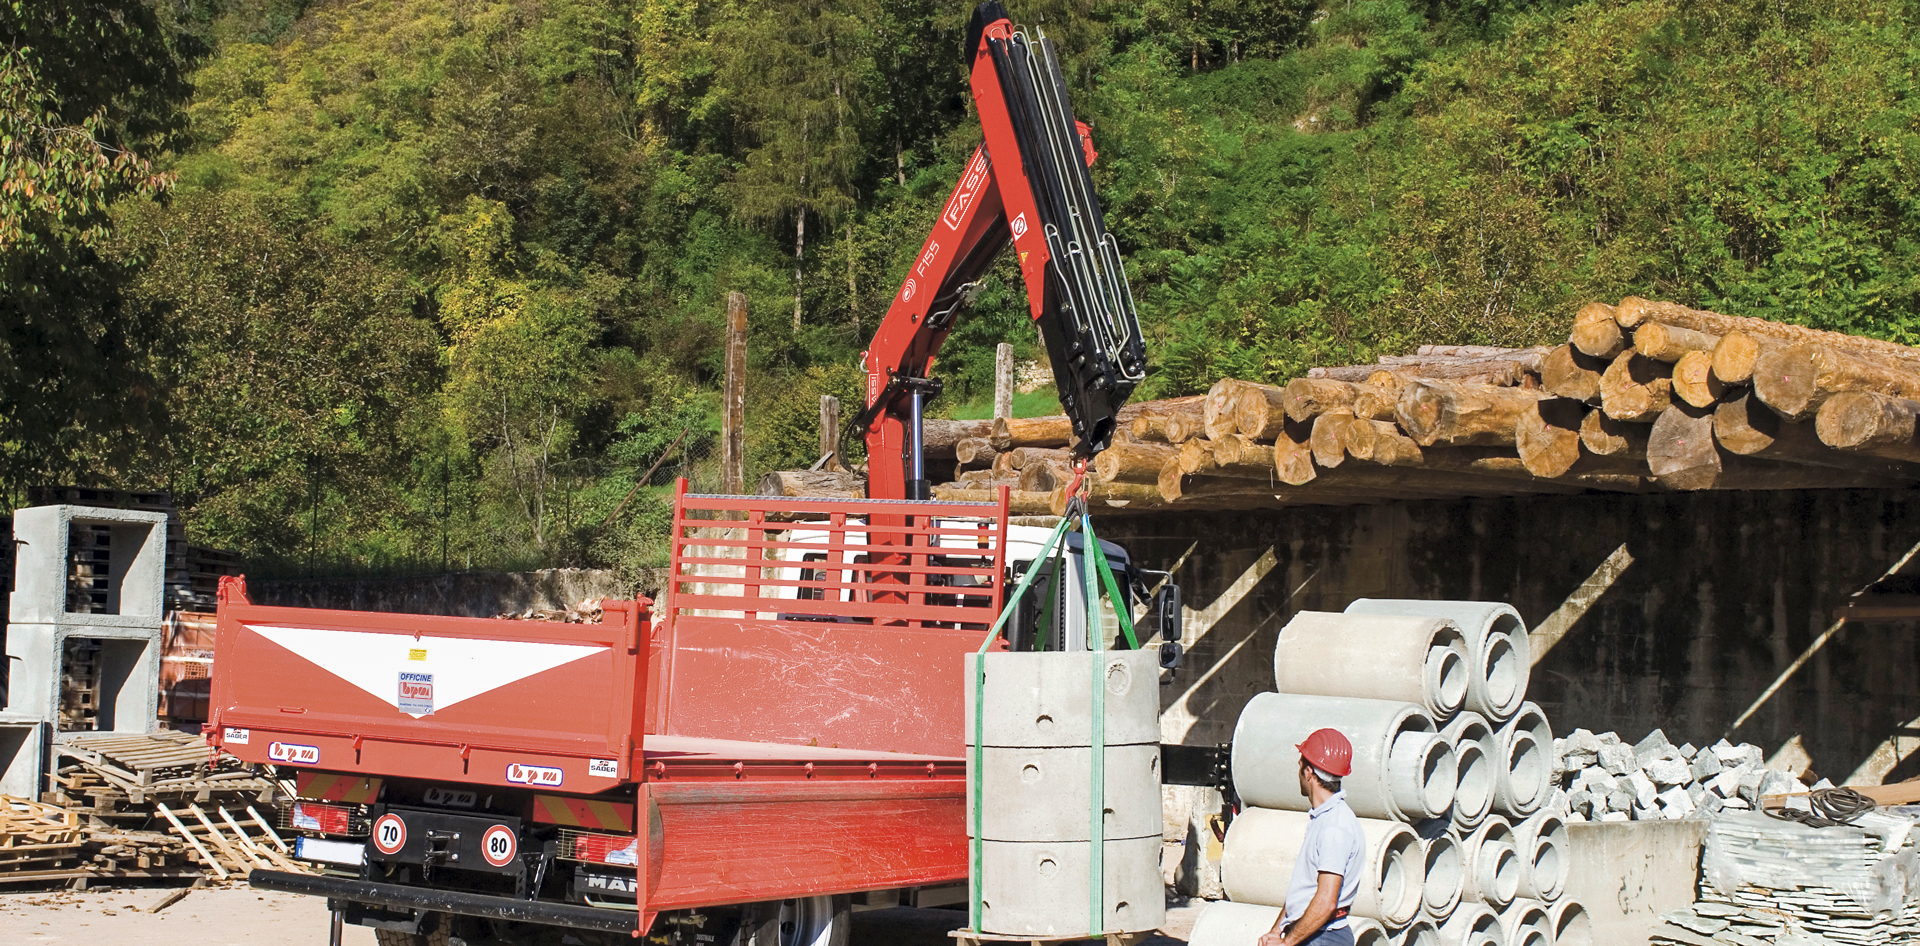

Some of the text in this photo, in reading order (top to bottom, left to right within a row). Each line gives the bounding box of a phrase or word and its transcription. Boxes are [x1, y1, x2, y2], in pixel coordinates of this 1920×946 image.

[916, 239, 940, 278] F155
[400, 673, 432, 682] OFFICINE
[590, 765, 616, 773] SADER
[383, 826, 398, 842] 70
[491, 837, 507, 853] 80
